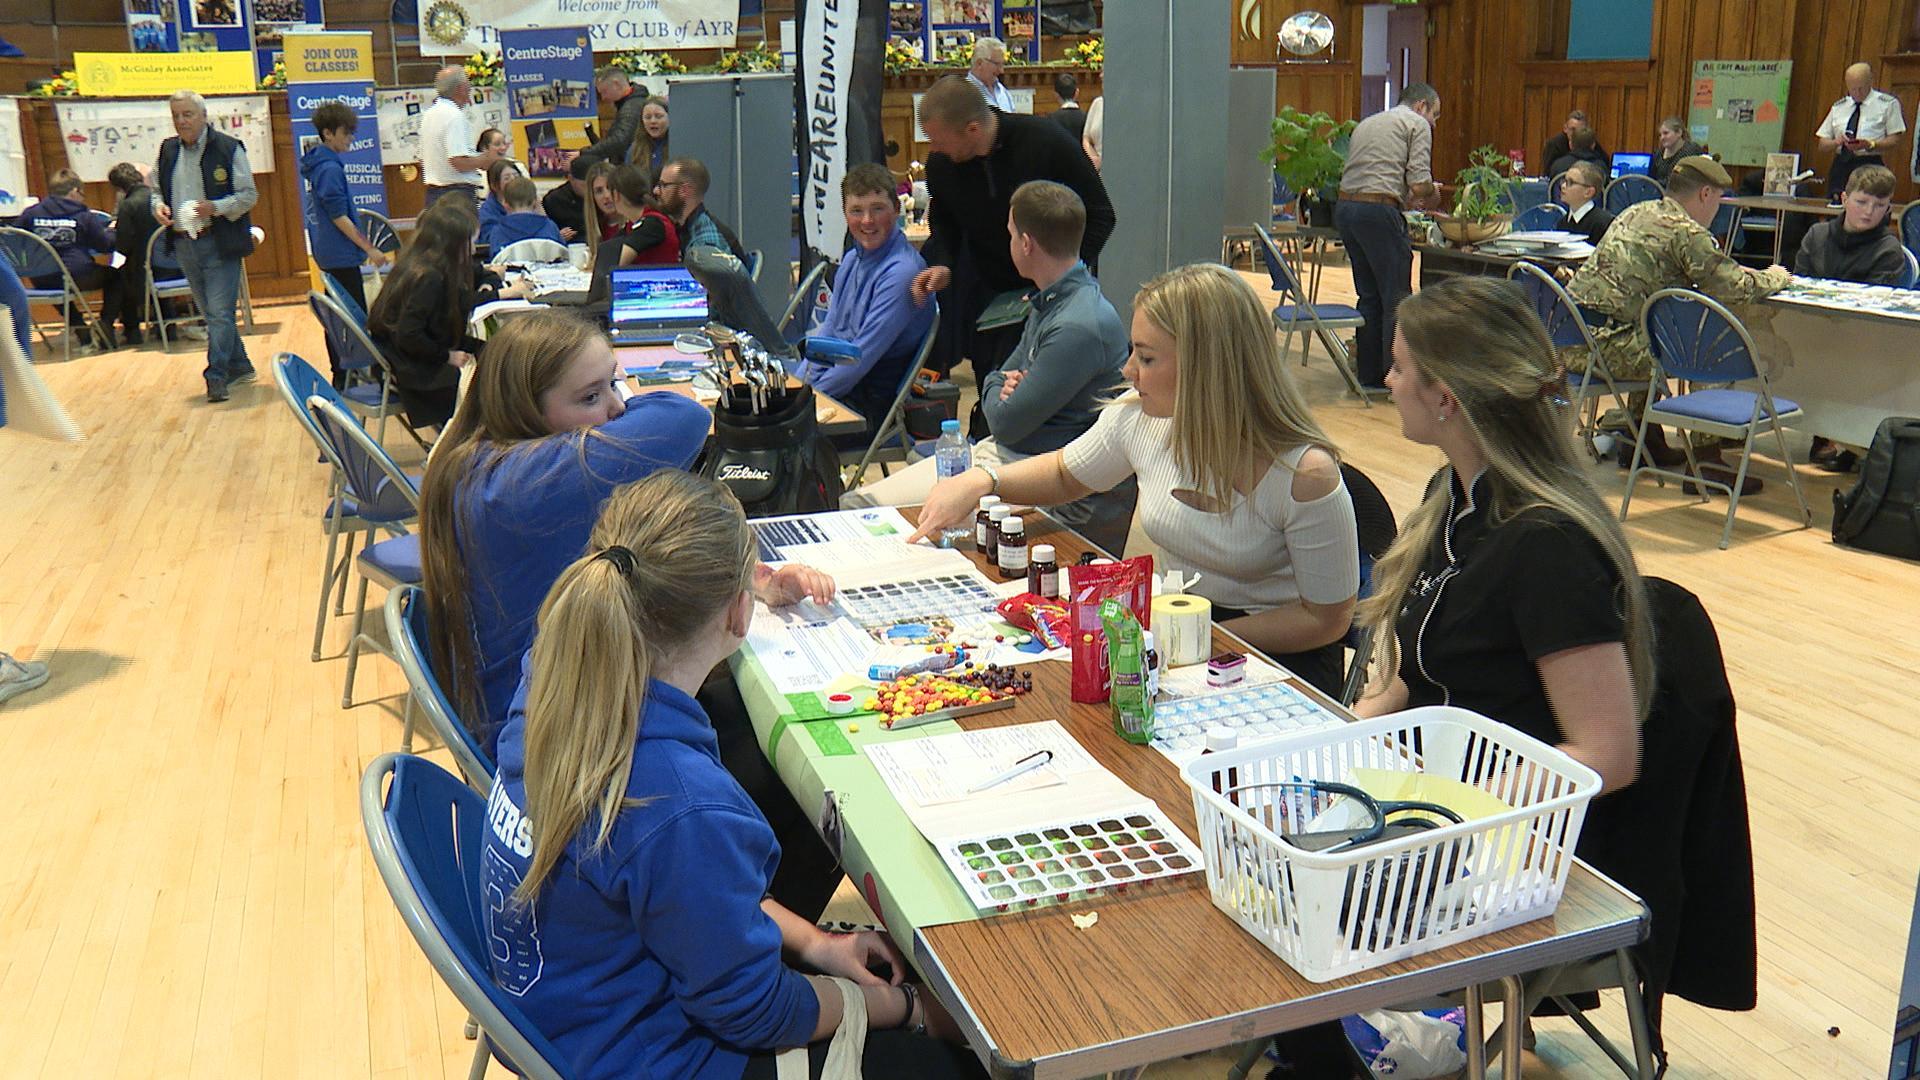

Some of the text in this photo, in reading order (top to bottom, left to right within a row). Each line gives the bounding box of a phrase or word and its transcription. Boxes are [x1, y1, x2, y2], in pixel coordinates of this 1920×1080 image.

[557, 0, 659, 13] Welcome from
[616, 19, 669, 38] CLUB
[674, 20, 690, 41] of
[694, 20, 735, 37] AYR
[303, 48, 358, 60] JOIN OUR
[507, 45, 583, 60] CentreStage
[120, 64, 213, 75] McGinley Associates
[305, 61, 359, 73] CLASSES!
[509, 73, 544, 82] CLASSES
[349, 138, 375, 151] ANCE
[346, 174, 383, 184] HEATRE
[353, 194, 382, 205] CTING
[718, 464, 771, 480] Titleist
